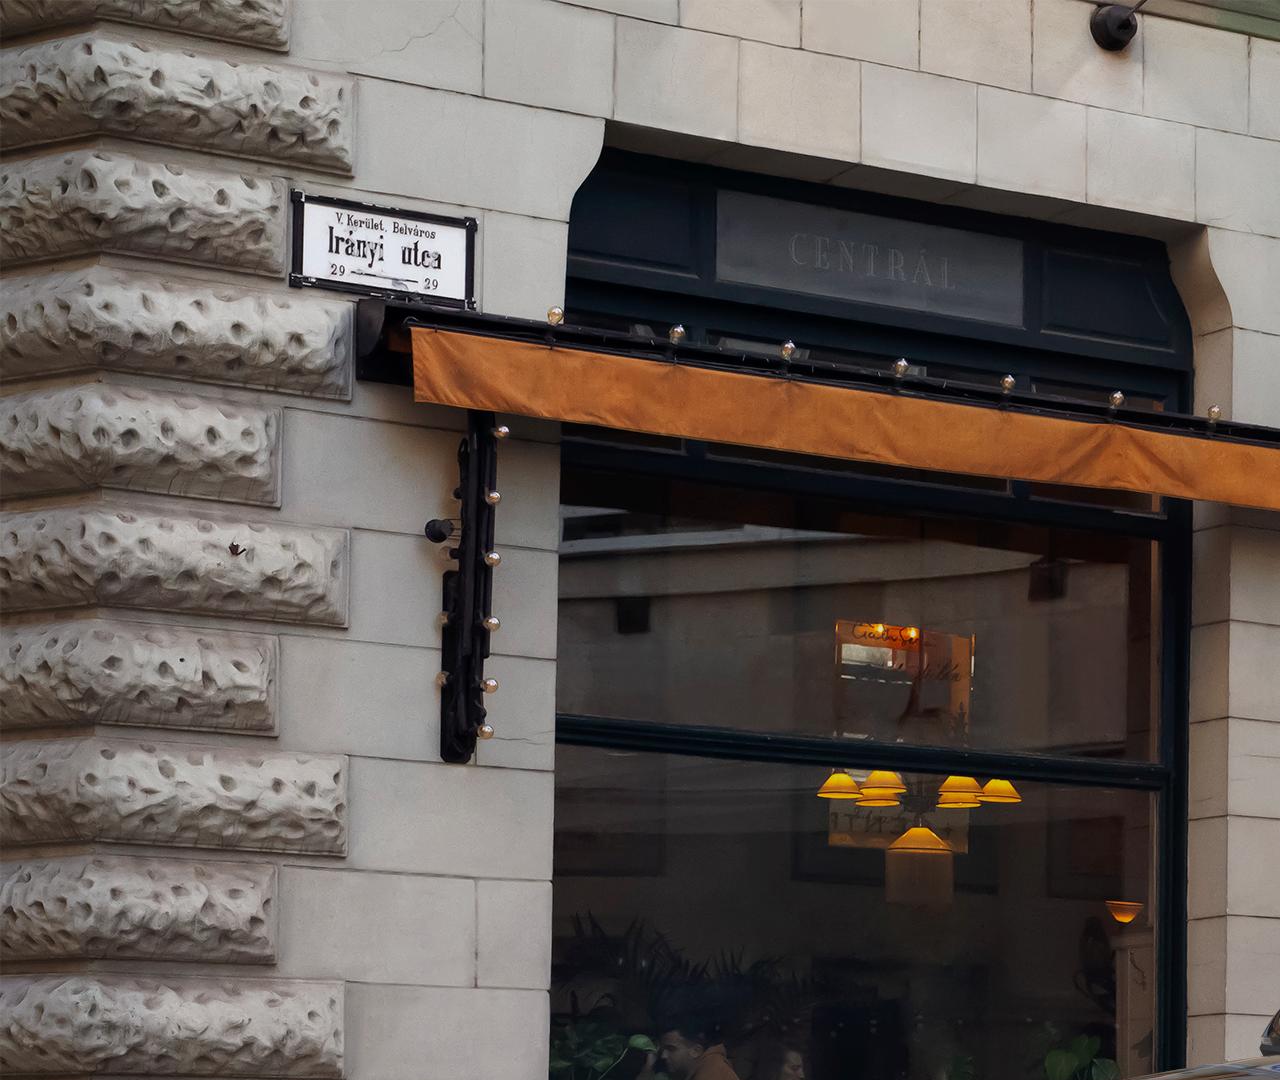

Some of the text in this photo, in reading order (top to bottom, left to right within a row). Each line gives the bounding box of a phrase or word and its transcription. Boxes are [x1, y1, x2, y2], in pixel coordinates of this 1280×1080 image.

[335, 212, 344, 225] V.
[392, 222, 437, 240] Belváros
[328, 225, 442, 270] Irányi utca
[330, 263, 439, 291] 29 29
